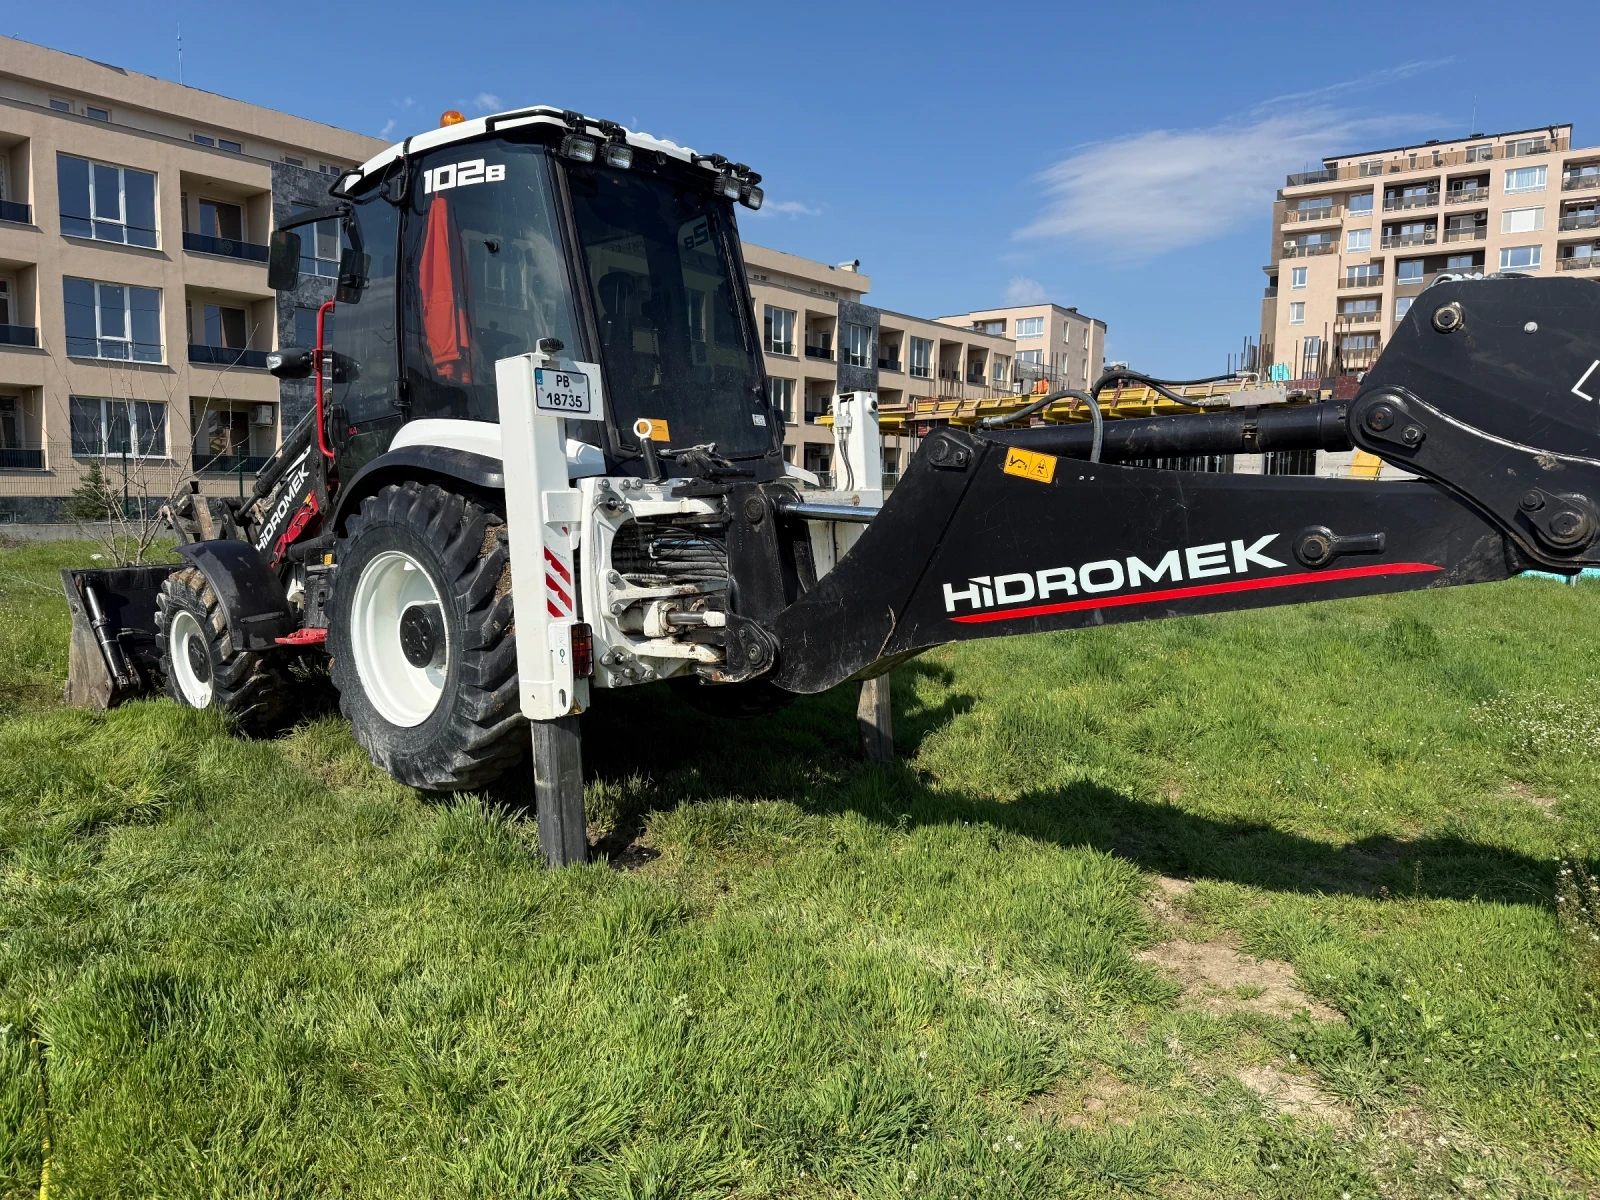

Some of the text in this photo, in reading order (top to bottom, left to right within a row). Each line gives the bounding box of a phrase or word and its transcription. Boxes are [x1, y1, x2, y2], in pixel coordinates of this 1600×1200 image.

[424, 158, 506, 195] 102B
[556, 374, 570, 388] PB
[546, 392, 583, 408] 18735
